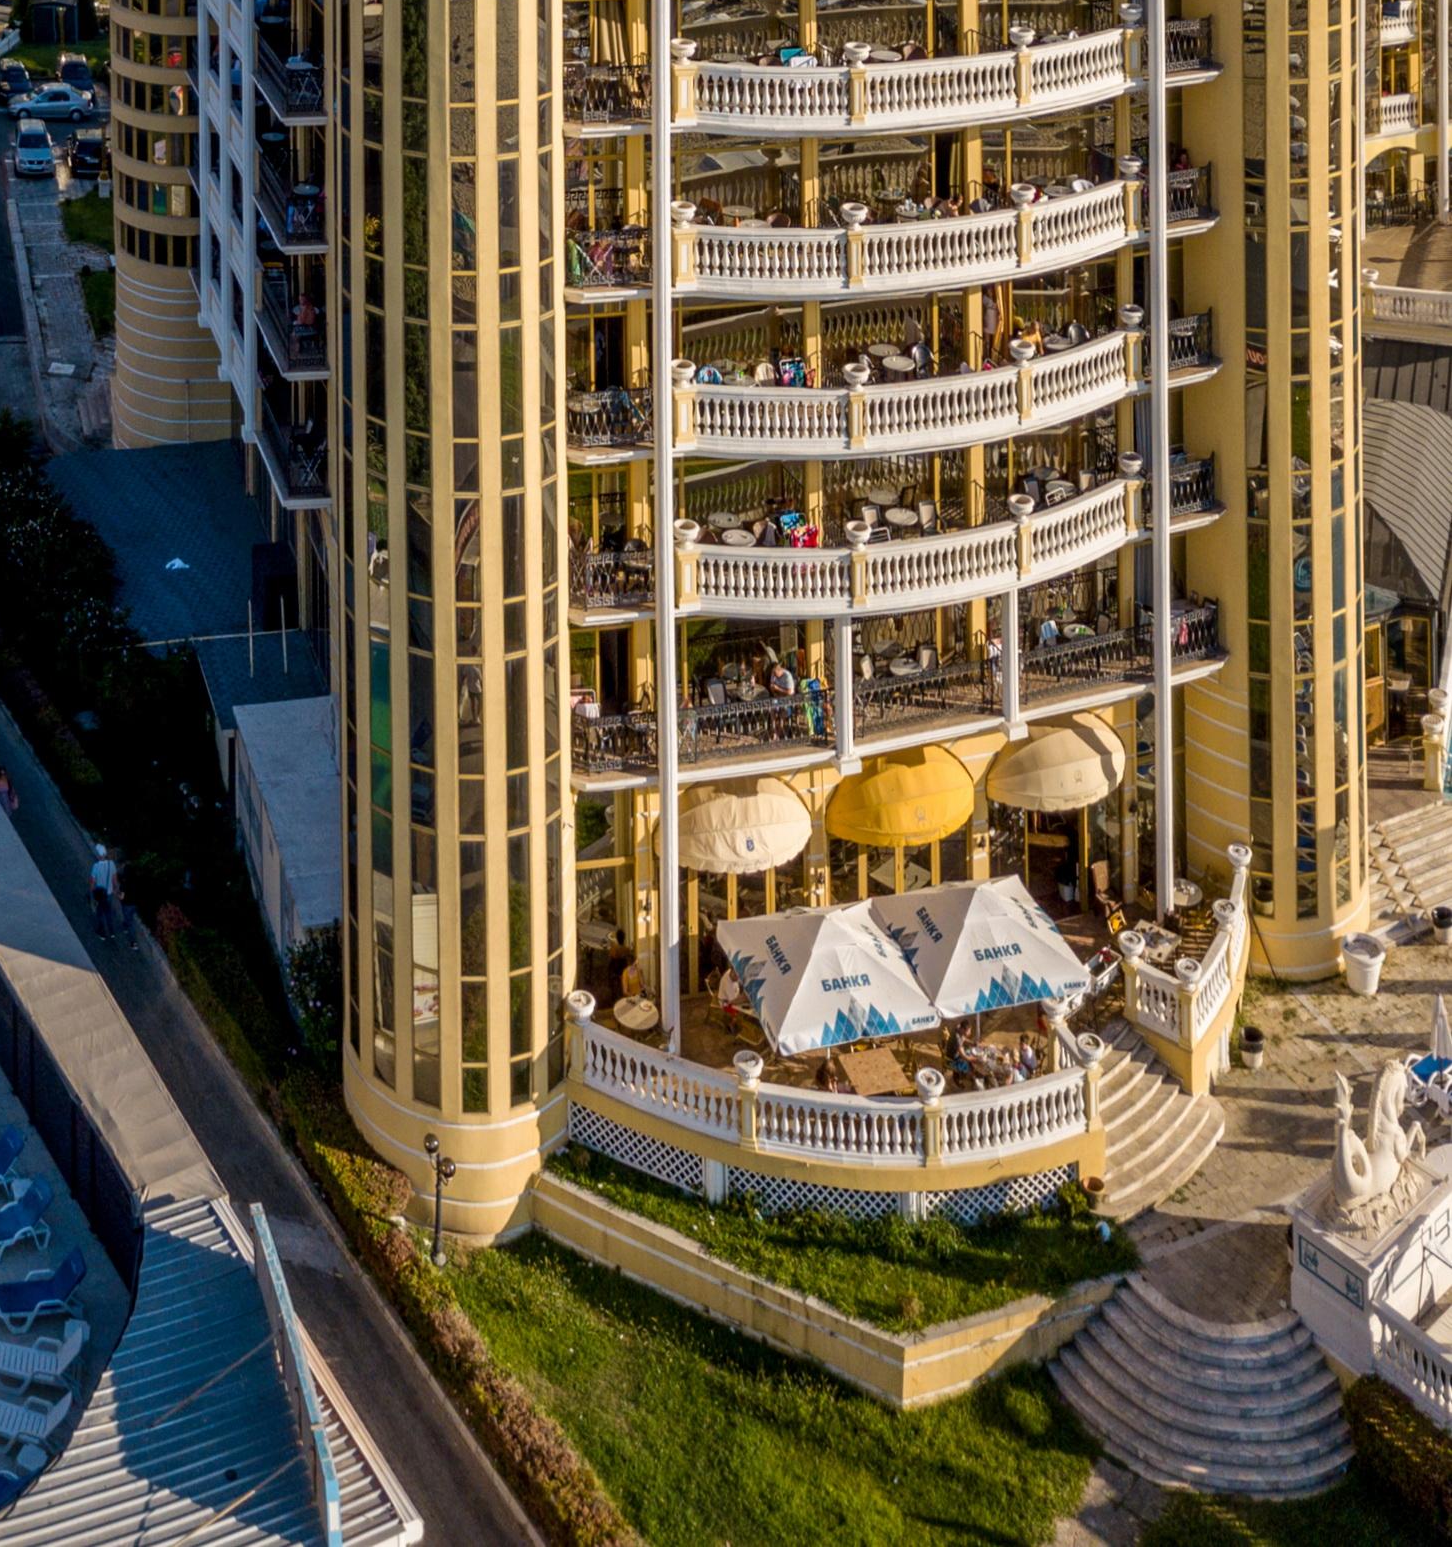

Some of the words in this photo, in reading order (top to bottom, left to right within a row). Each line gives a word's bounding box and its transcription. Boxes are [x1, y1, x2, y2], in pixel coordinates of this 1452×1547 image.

[916, 906, 943, 944] БАНКЯ
[765, 935, 792, 976] БАНКЯ
[973, 942, 1023, 962] БАНКЯ
[821, 973, 871, 992] БАНКЯ
